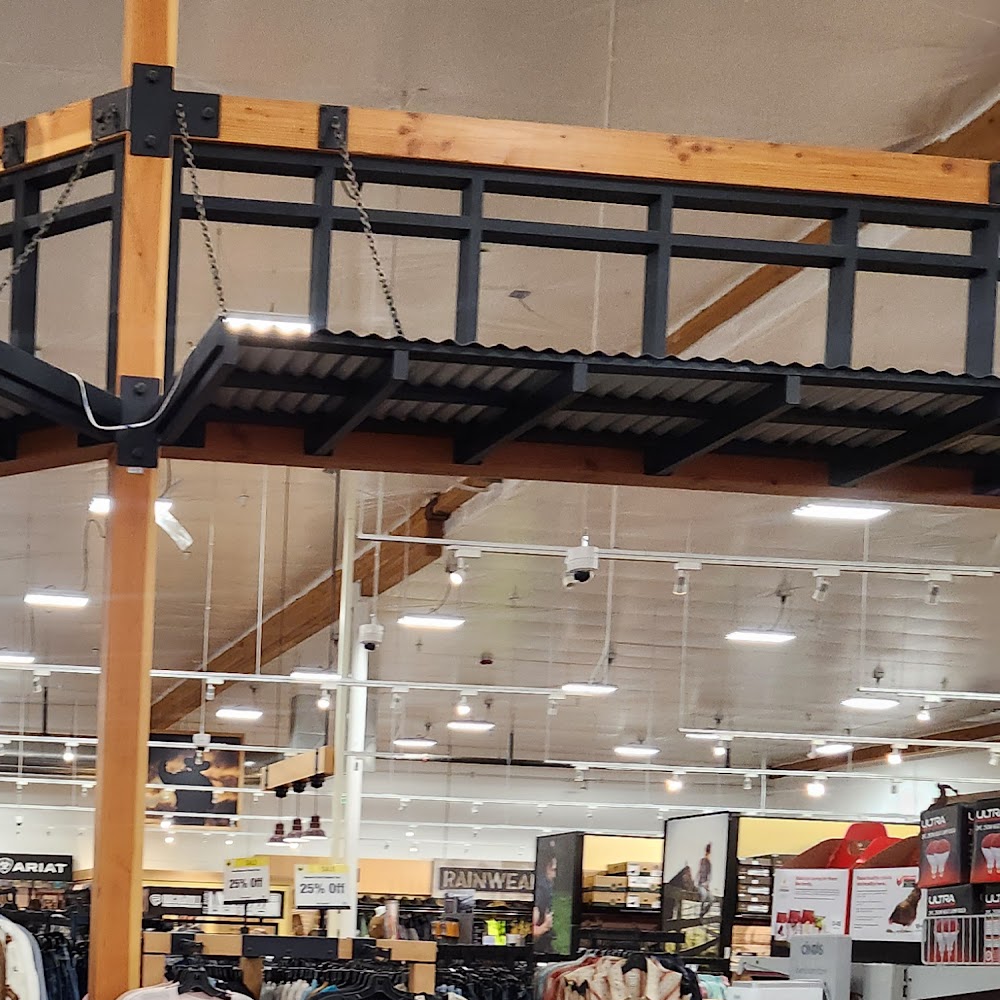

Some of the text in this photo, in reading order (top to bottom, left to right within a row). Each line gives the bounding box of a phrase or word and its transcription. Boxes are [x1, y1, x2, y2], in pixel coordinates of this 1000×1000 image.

[921, 815, 946, 829] ULTRA
[12, 861, 68, 874] ARIAT
[300, 883, 346, 894] 25% Off
[928, 893, 956, 904] ULTRA
